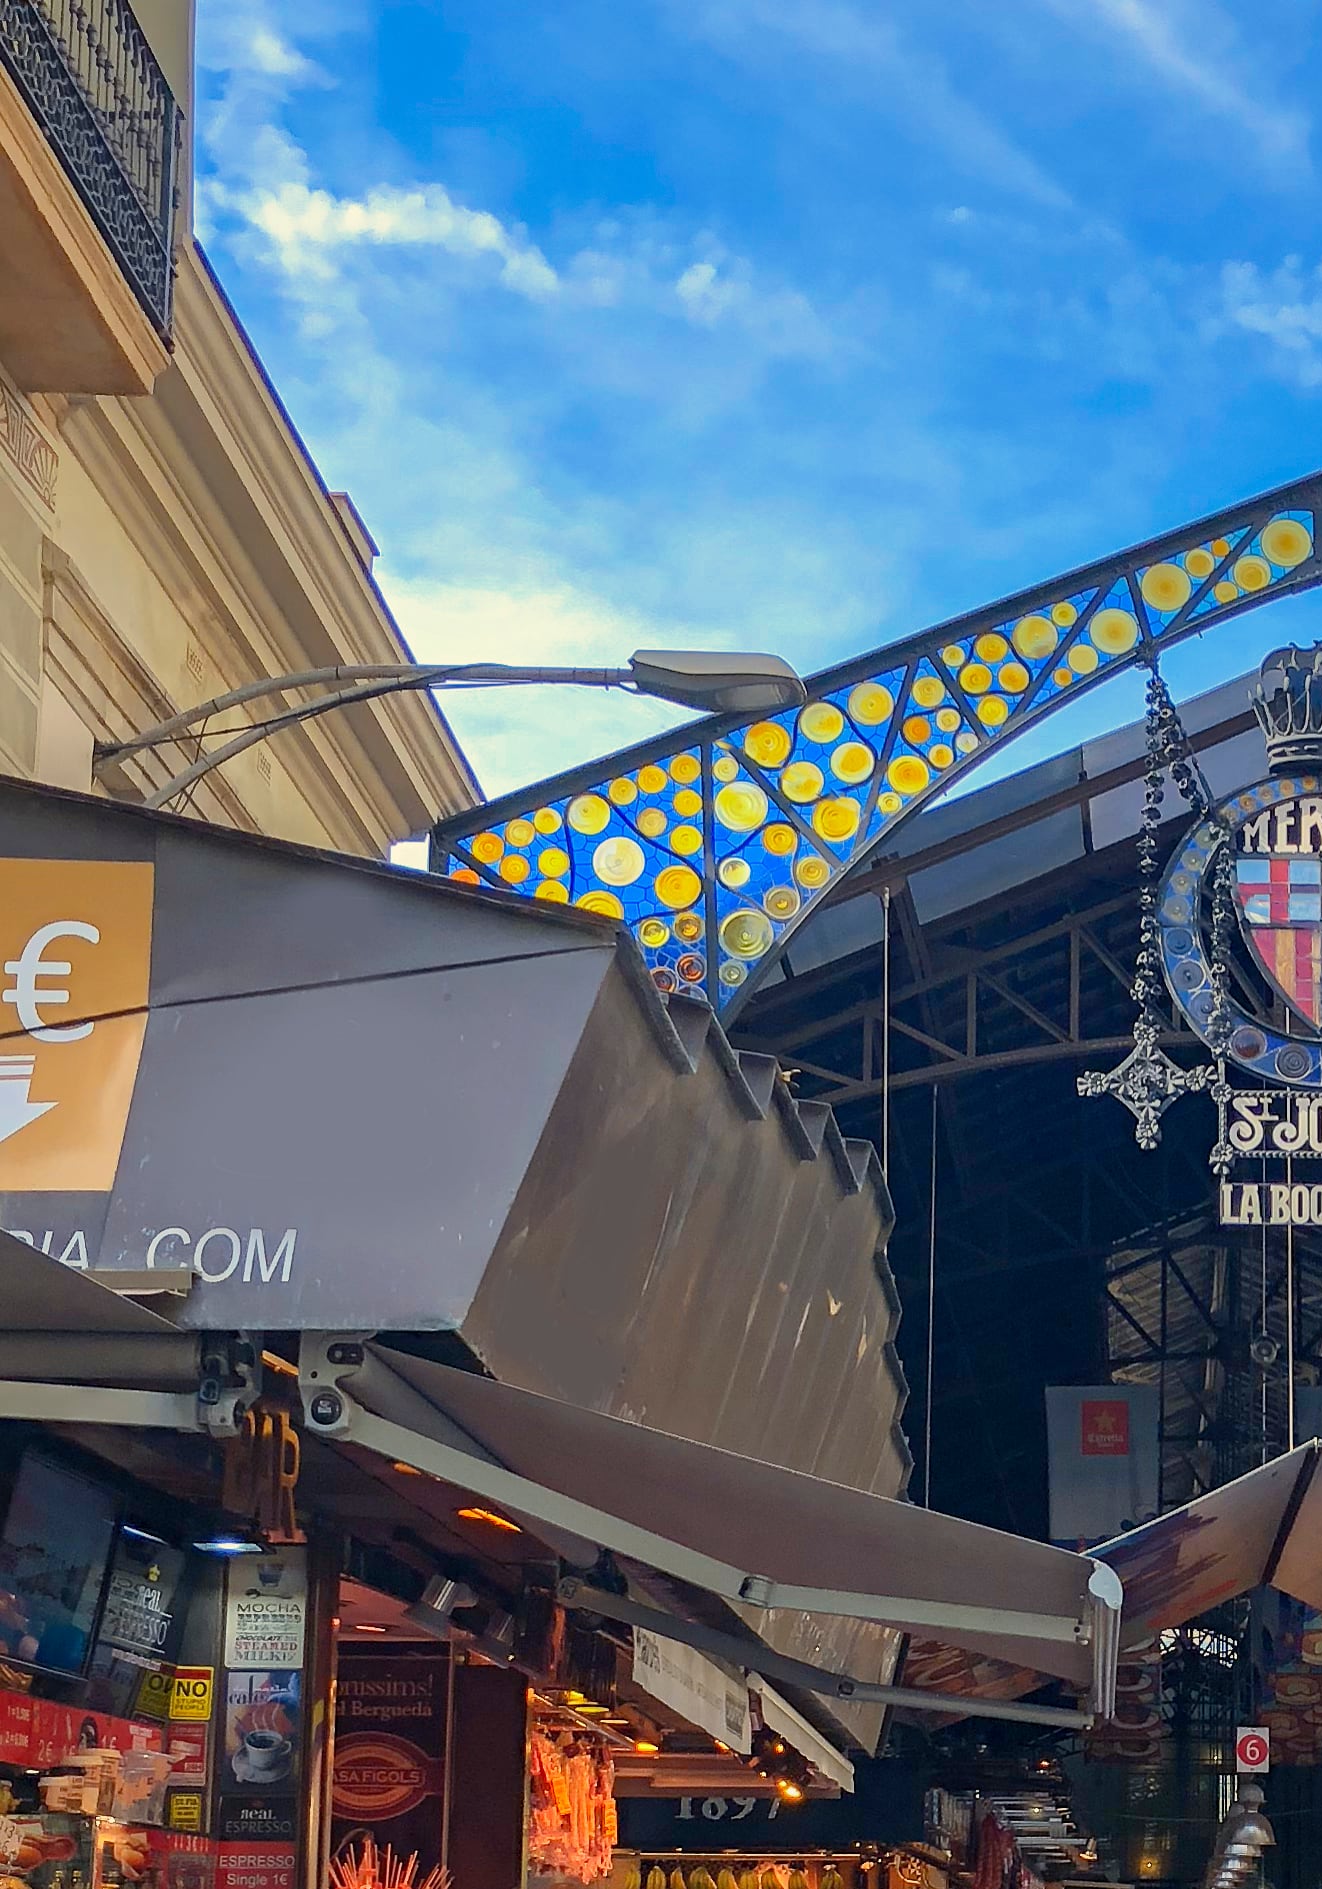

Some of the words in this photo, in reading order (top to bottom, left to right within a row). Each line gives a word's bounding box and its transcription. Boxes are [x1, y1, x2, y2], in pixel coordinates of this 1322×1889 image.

[1221, 1185, 1262, 1225] LA
[237, 1603, 301, 1613] MOCHA
[235, 1641, 298, 1651] STEAMED
[176, 1681, 207, 1697] NO
[1245, 1739, 1260, 1760] 6
[225, 1820, 292, 1834] ESPRESSO
[219, 1855, 296, 1868] ESPRESSO
[226, 1873, 268, 1887] Single
[273, 1874, 288, 1886] 1€
